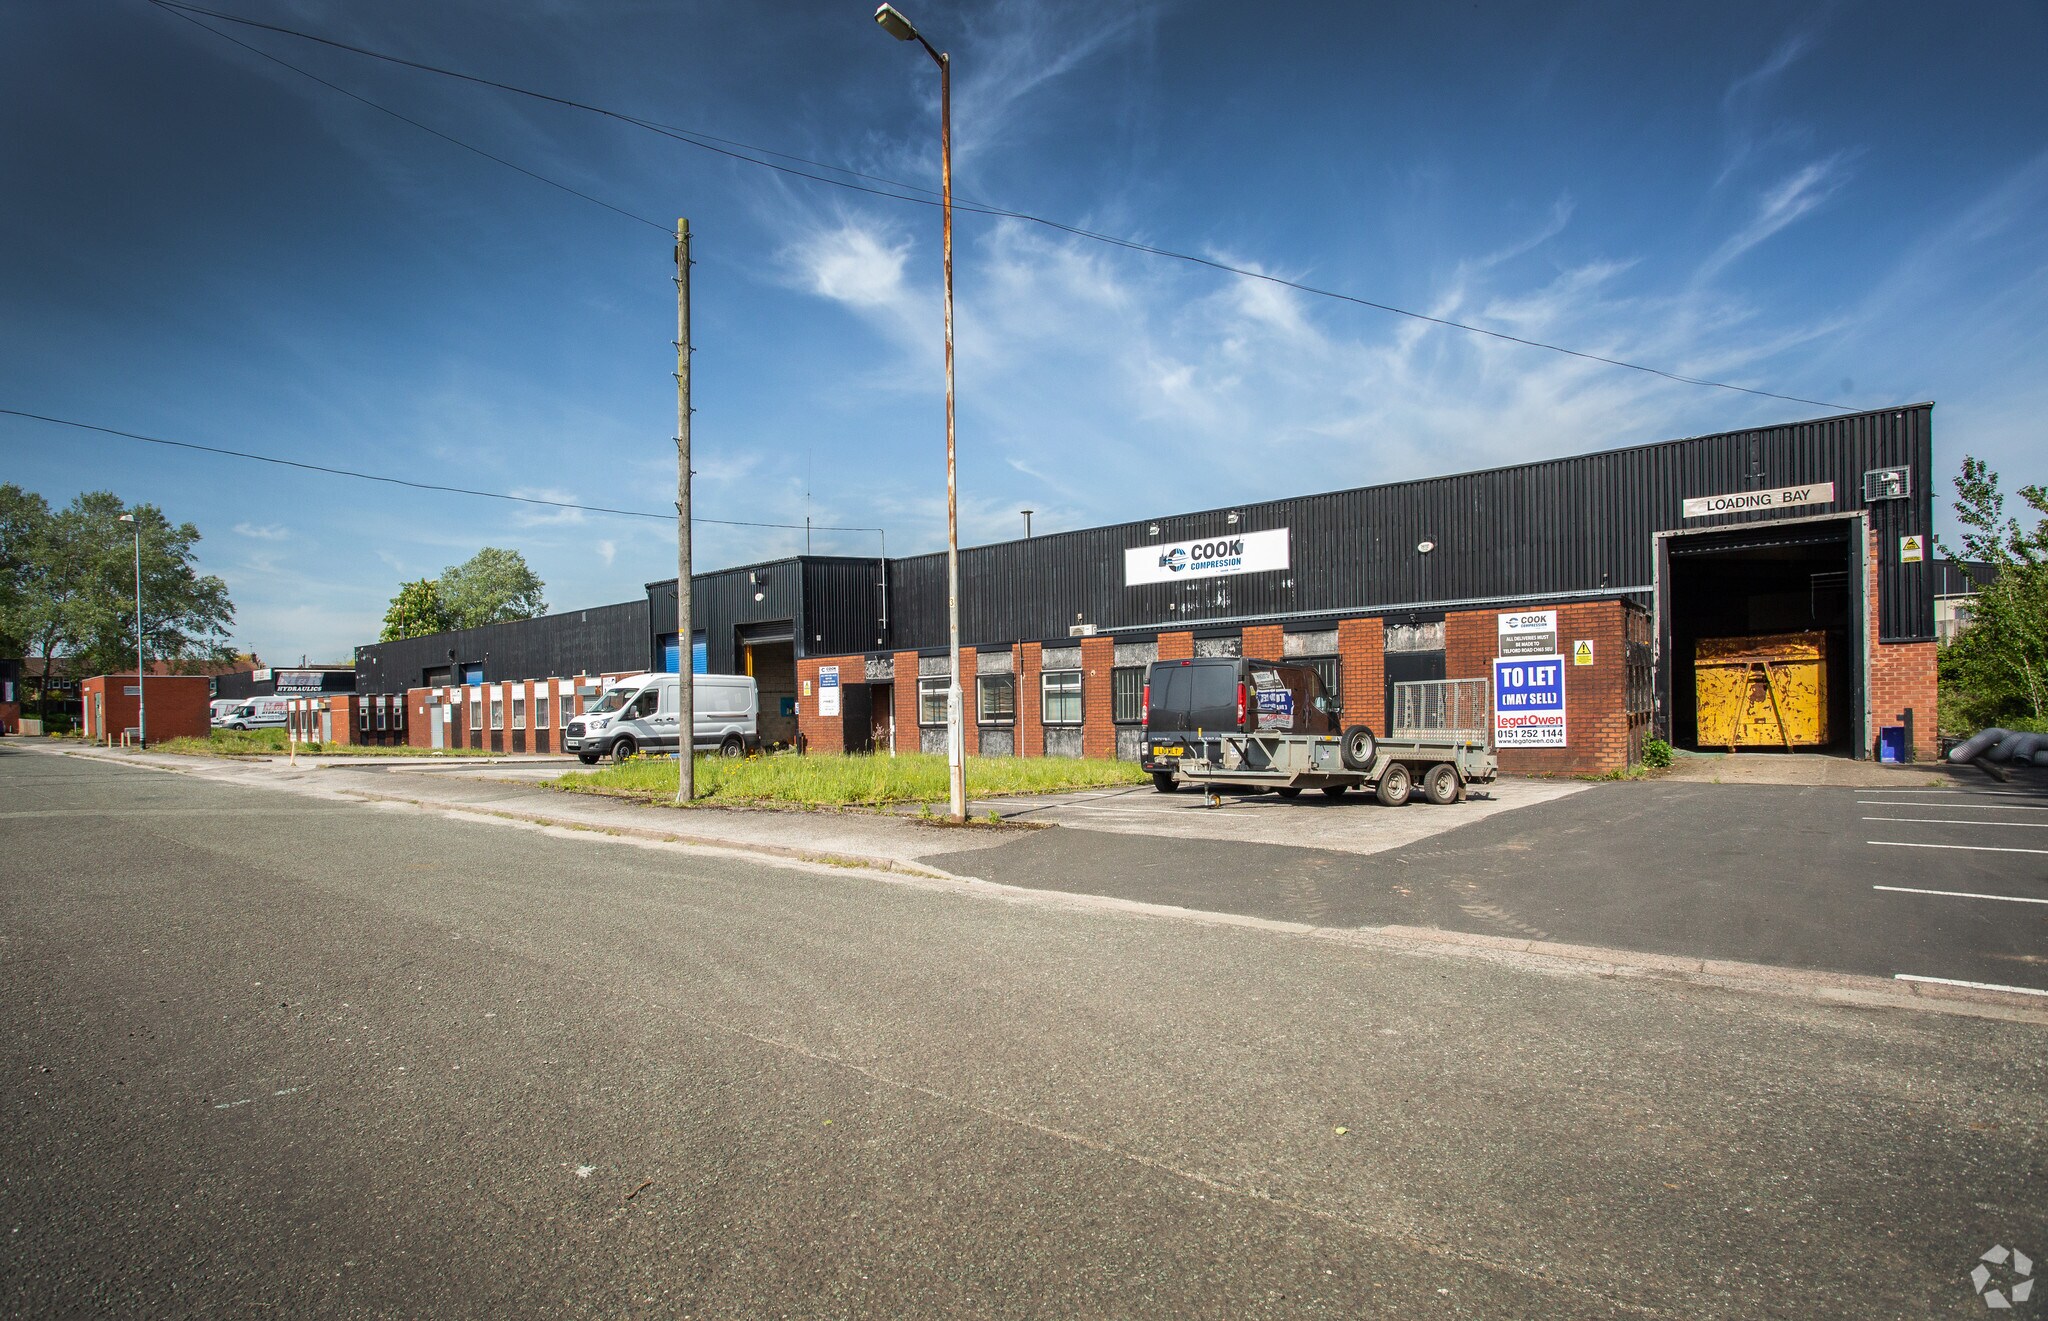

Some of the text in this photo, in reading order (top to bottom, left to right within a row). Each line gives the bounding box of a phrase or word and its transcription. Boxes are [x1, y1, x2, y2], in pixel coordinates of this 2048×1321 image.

[1707, 489, 1811, 511] LOADING BAY
[1191, 540, 1240, 560] COOK
[1191, 557, 1241, 570] COMPRESSION
[1521, 615, 1547, 624] COOK
[1501, 666, 1556, 688] TO LET
[1502, 692, 1557, 706] (MAY SELL)
[1498, 729, 1563, 738] 0151 252 1144
[1498, 737, 1563, 745] www.legatowen.co.uk
